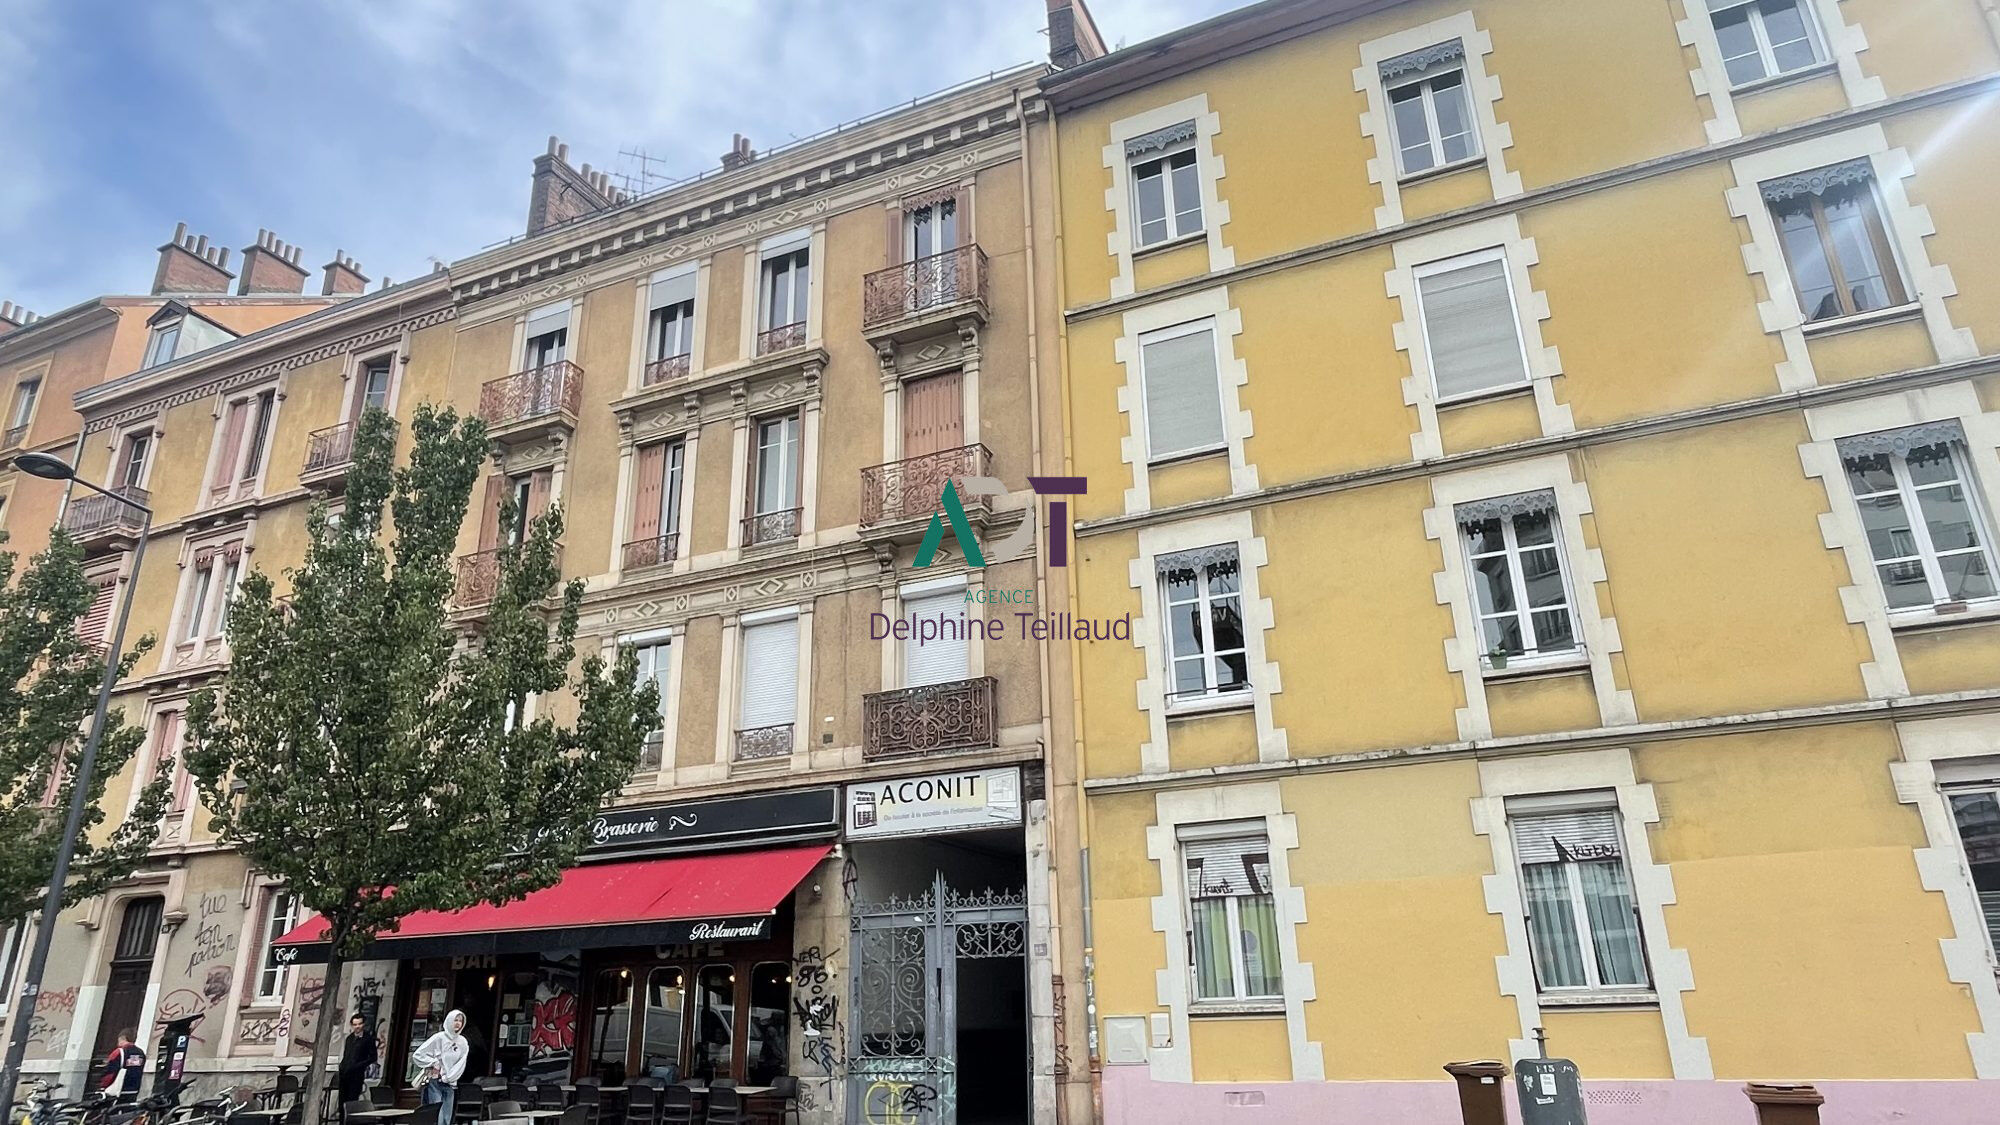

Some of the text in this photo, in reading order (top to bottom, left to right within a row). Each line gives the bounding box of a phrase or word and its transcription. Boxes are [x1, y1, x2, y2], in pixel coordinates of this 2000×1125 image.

[880, 775, 980, 805] ACONIT
[592, 816, 659, 844] Brasserie
[689, 918, 765, 941] Restaurant
